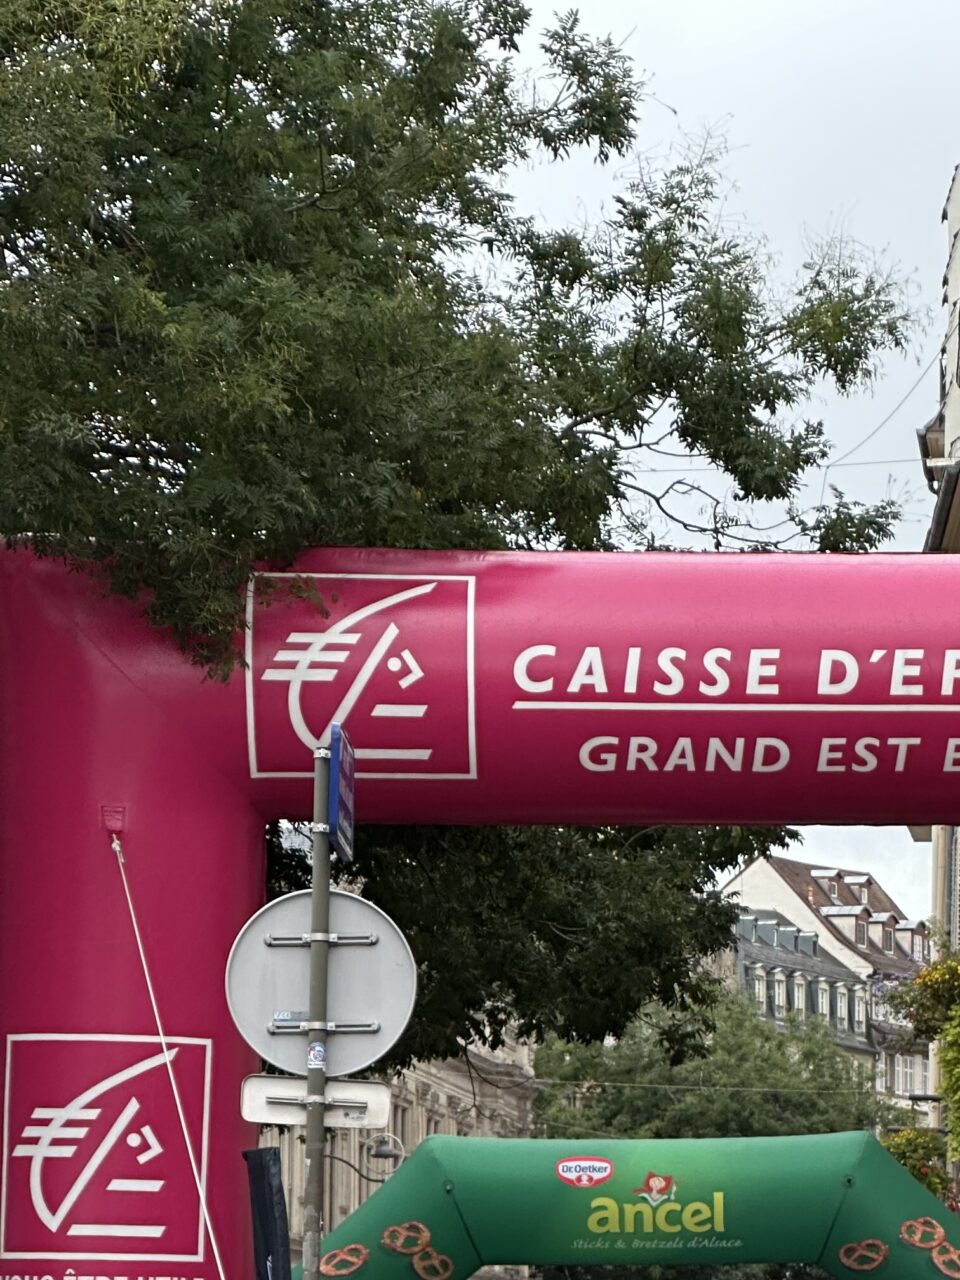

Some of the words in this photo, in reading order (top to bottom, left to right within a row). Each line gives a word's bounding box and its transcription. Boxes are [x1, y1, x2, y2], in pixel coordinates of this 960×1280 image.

[513, 644, 780, 697] CAISSE
[579, 736, 791, 774] GRAND
[816, 736, 921, 773] EST
[574, 1164, 609, 1174] Oetker
[587, 1192, 725, 1233] ancel
[571, 1237, 610, 1249] Sticks
[614, 1238, 626, 1249] &
[631, 1236, 684, 1249] Bretzels
[687, 1235, 743, 1249] d'Alsace
